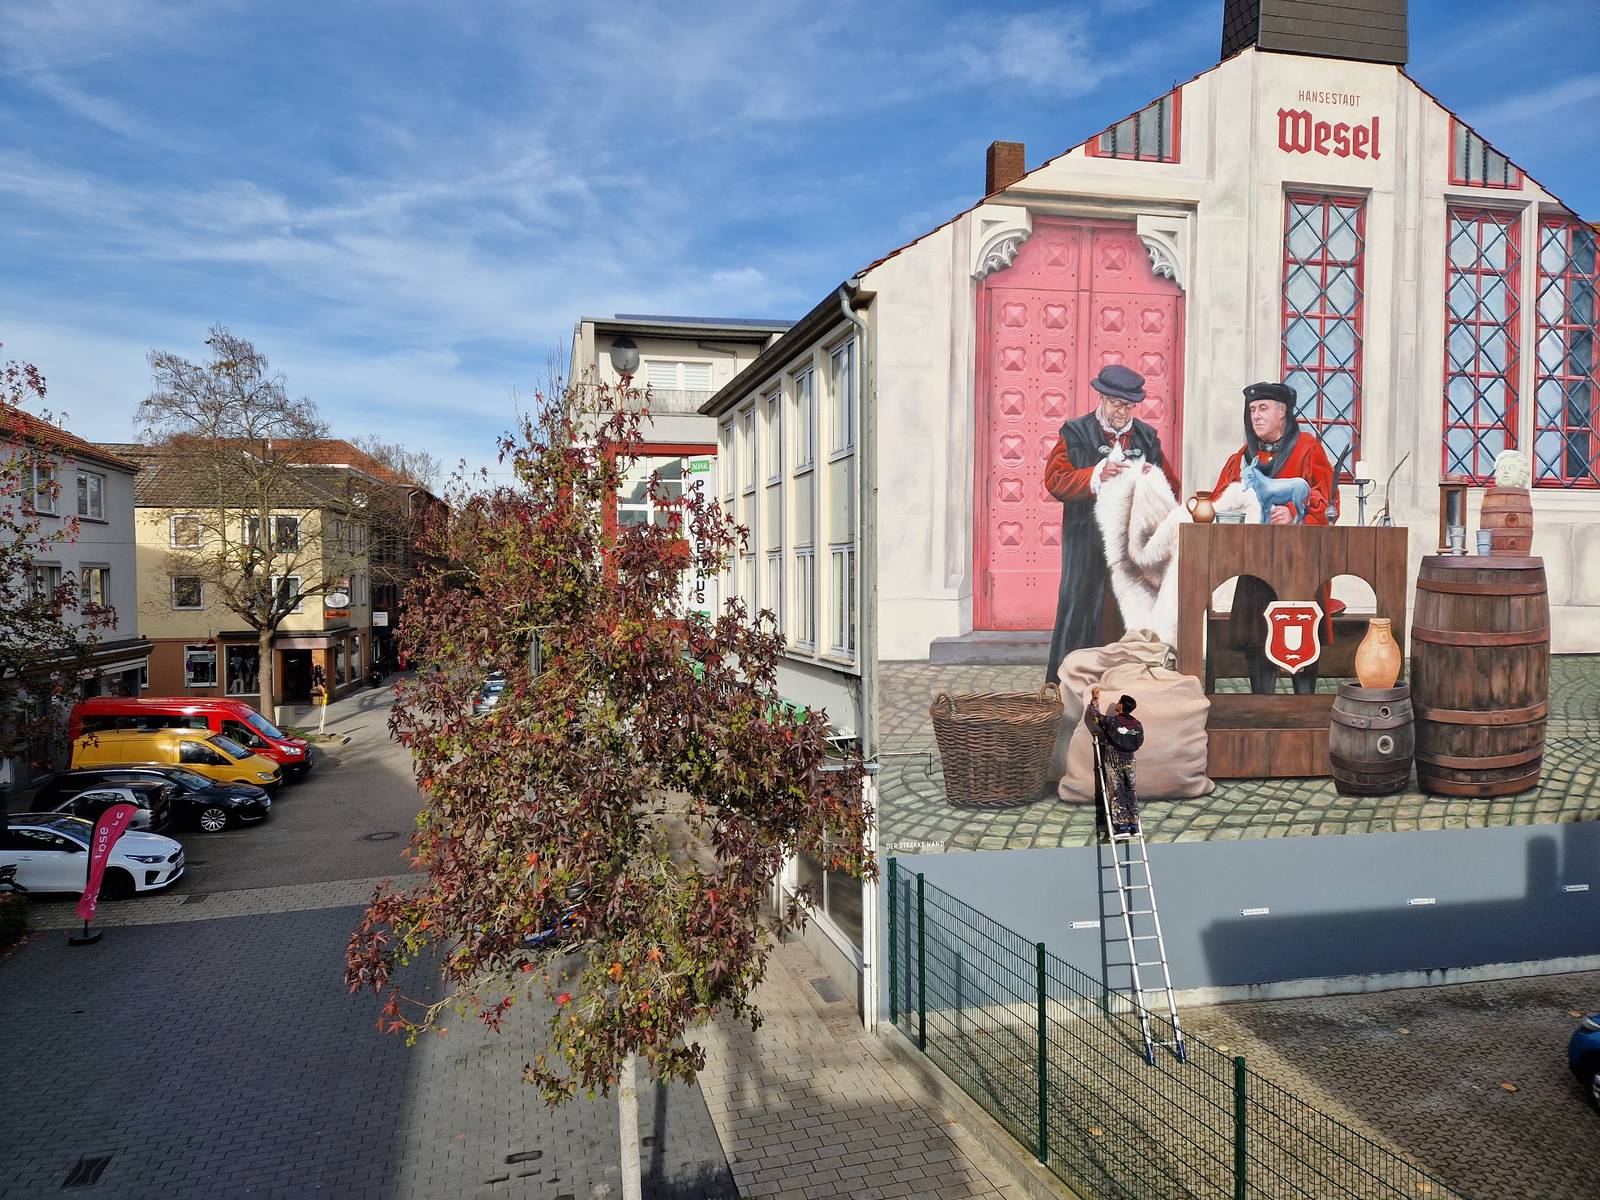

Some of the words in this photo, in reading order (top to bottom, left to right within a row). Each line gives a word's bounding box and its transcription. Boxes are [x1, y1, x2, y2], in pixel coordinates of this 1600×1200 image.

[1298, 90, 1361, 107] HANSESTADT
[1277, 107, 1381, 161] Wesel
[926, 840, 945, 848] HAND
